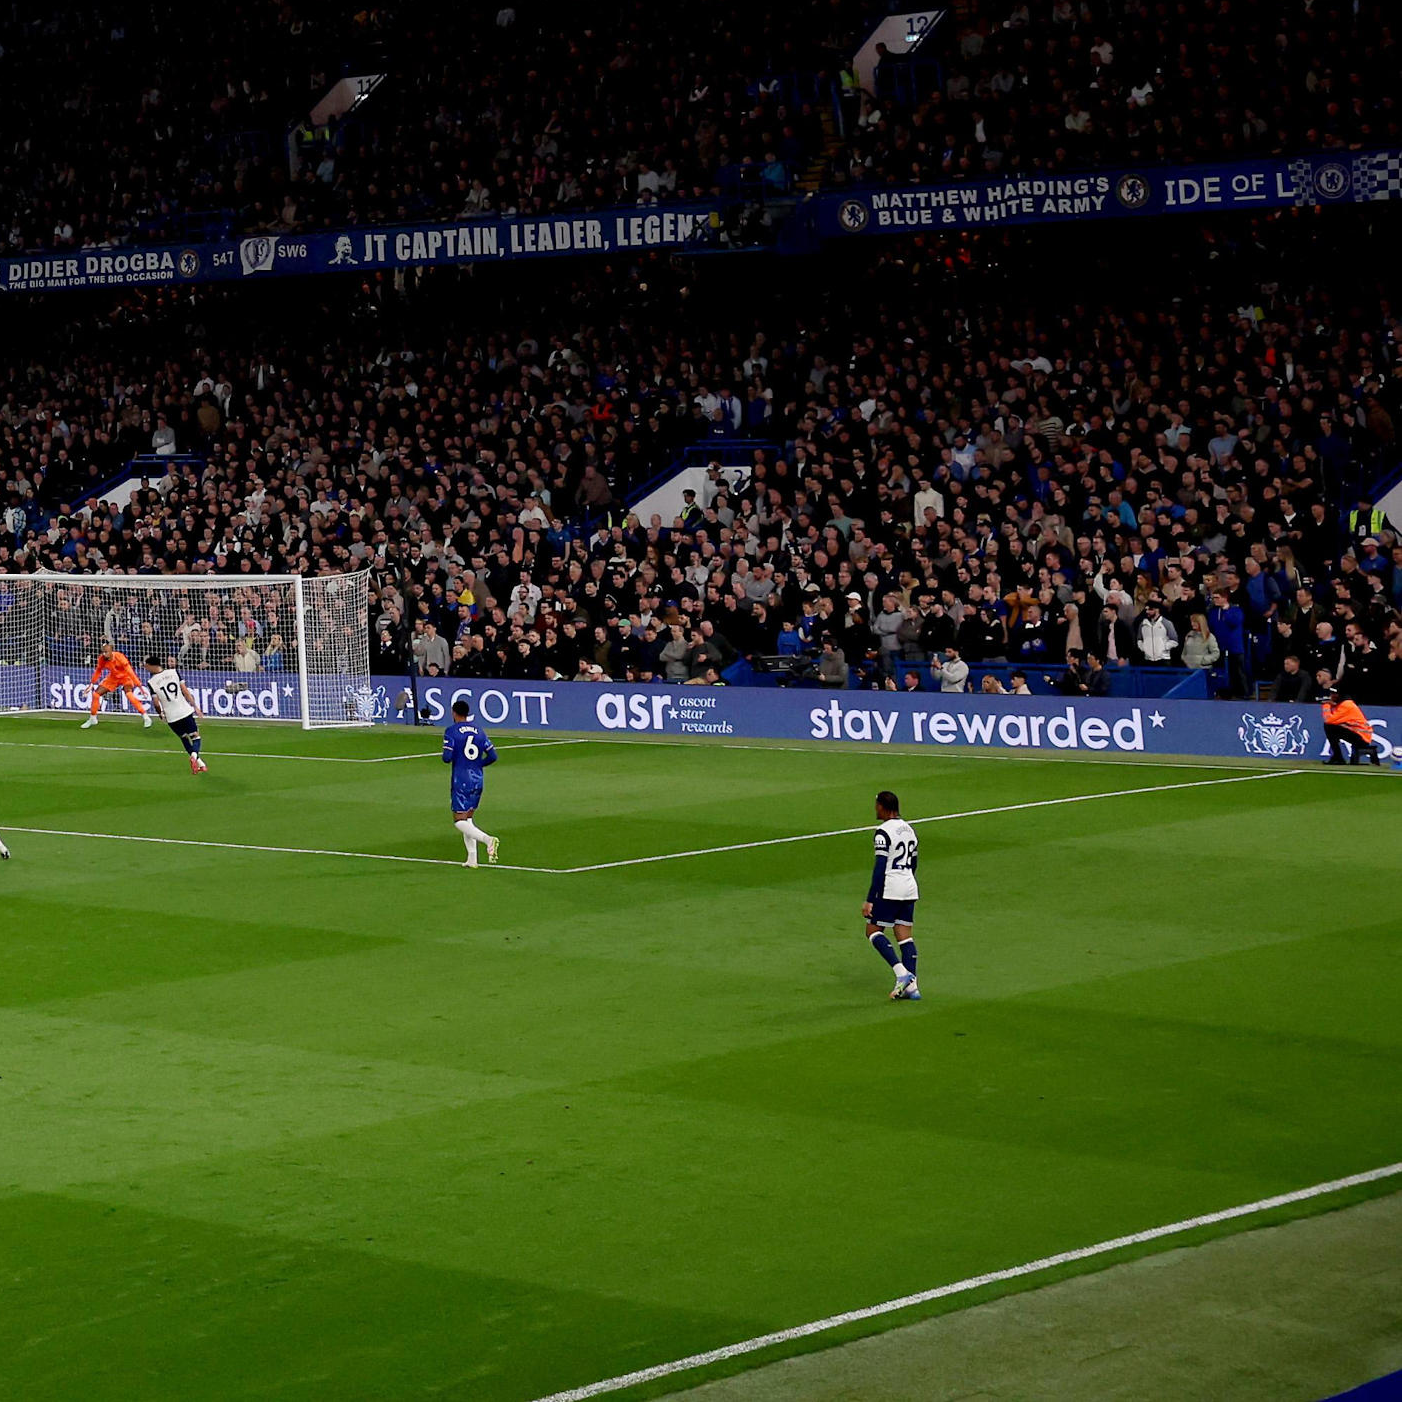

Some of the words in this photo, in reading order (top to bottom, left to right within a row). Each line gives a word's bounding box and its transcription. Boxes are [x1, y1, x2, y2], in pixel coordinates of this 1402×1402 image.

[907, 16, 928, 35] 12
[872, 188, 978, 210] MATTHEW
[987, 177, 1109, 202] HARDING'S
[1164, 177, 1222, 206] IDE
[1231, 174, 1265, 193] OF
[878, 209, 933, 226] BLUE
[941, 207, 956, 223] &
[963, 197, 1035, 222] WHITE
[1042, 195, 1105, 214] ARMY
[364, 234, 387, 263] JT
[396, 227, 504, 262] CAPTAIN,
[510, 219, 609, 254] LEADER,
[9, 259, 79, 281] DIDIER
[85, 251, 174, 274] DROGBA
[213, 251, 234, 267] 547
[278, 244, 307, 258] SW6
[9, 282, 27, 290] THE
[29, 280, 45, 288] BIG
[46, 278, 67, 287] MAN
[69, 276, 86, 285] FOR
[88, 275, 105, 284] THE
[107, 274, 123, 283] BIG
[126, 271, 174, 282] OCCASION
[160, 682, 178, 702] 19
[679, 696, 717, 708] ascott
[597, 692, 672, 730] asr
[680, 709, 706, 720] star
[681, 721, 733, 734] rewards
[809, 699, 899, 745] stay
[913, 707, 1145, 752] rewarded
[464, 735, 479, 761] 6
[891, 840, 917, 870] 28
